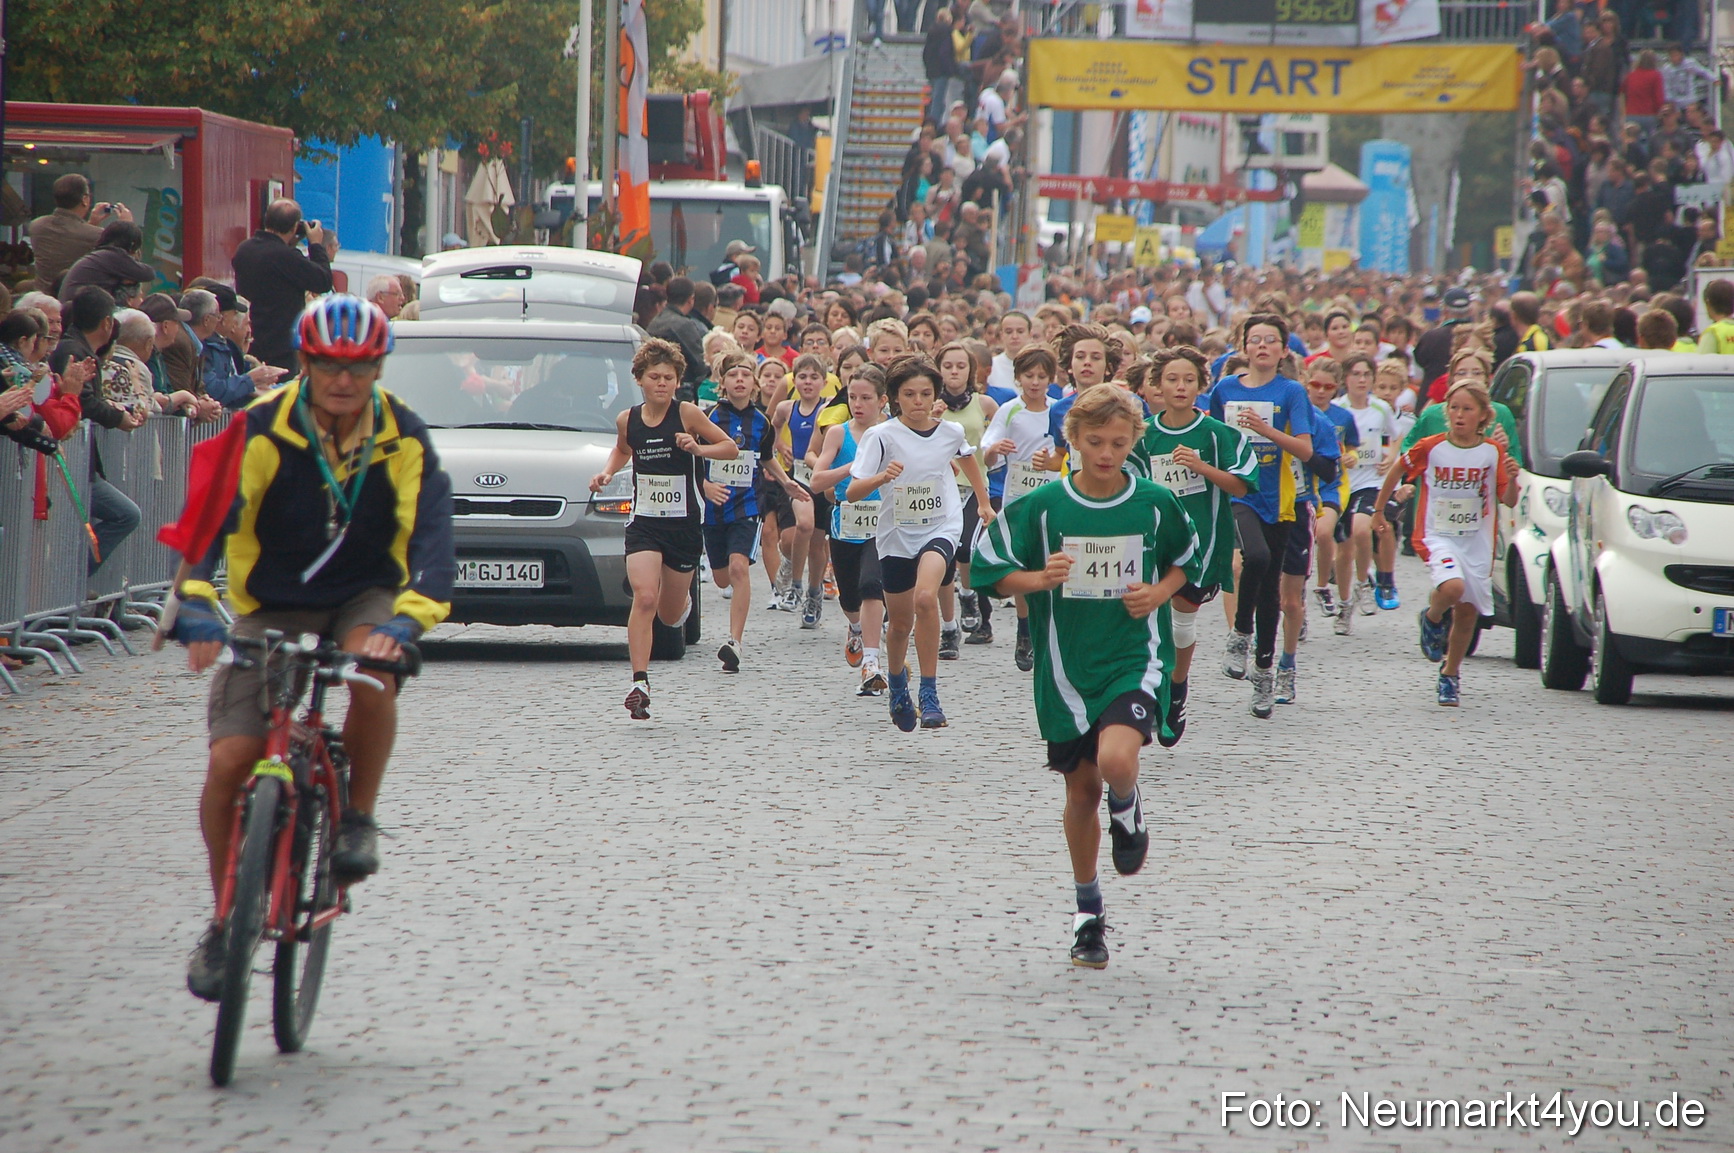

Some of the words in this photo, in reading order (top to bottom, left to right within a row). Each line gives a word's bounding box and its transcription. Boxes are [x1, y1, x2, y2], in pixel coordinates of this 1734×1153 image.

[1187, 57, 1351, 96] START
[1141, 238, 1155, 256] A
[646, 446, 673, 454] Marathon
[722, 463, 750, 475] 4103
[480, 475, 502, 485] KIA
[648, 478, 671, 487] Manuel
[907, 486, 931, 495] Philipp
[649, 491, 682, 503] 4009
[854, 503, 877, 512] Nadine
[909, 496, 942, 511] 4098
[854, 515, 878, 527] 410
[1448, 512, 1478, 524] 4064
[1085, 542, 1116, 554] Oliver
[506, 563, 539, 581] 140
[1086, 560, 1137, 578] 4114
